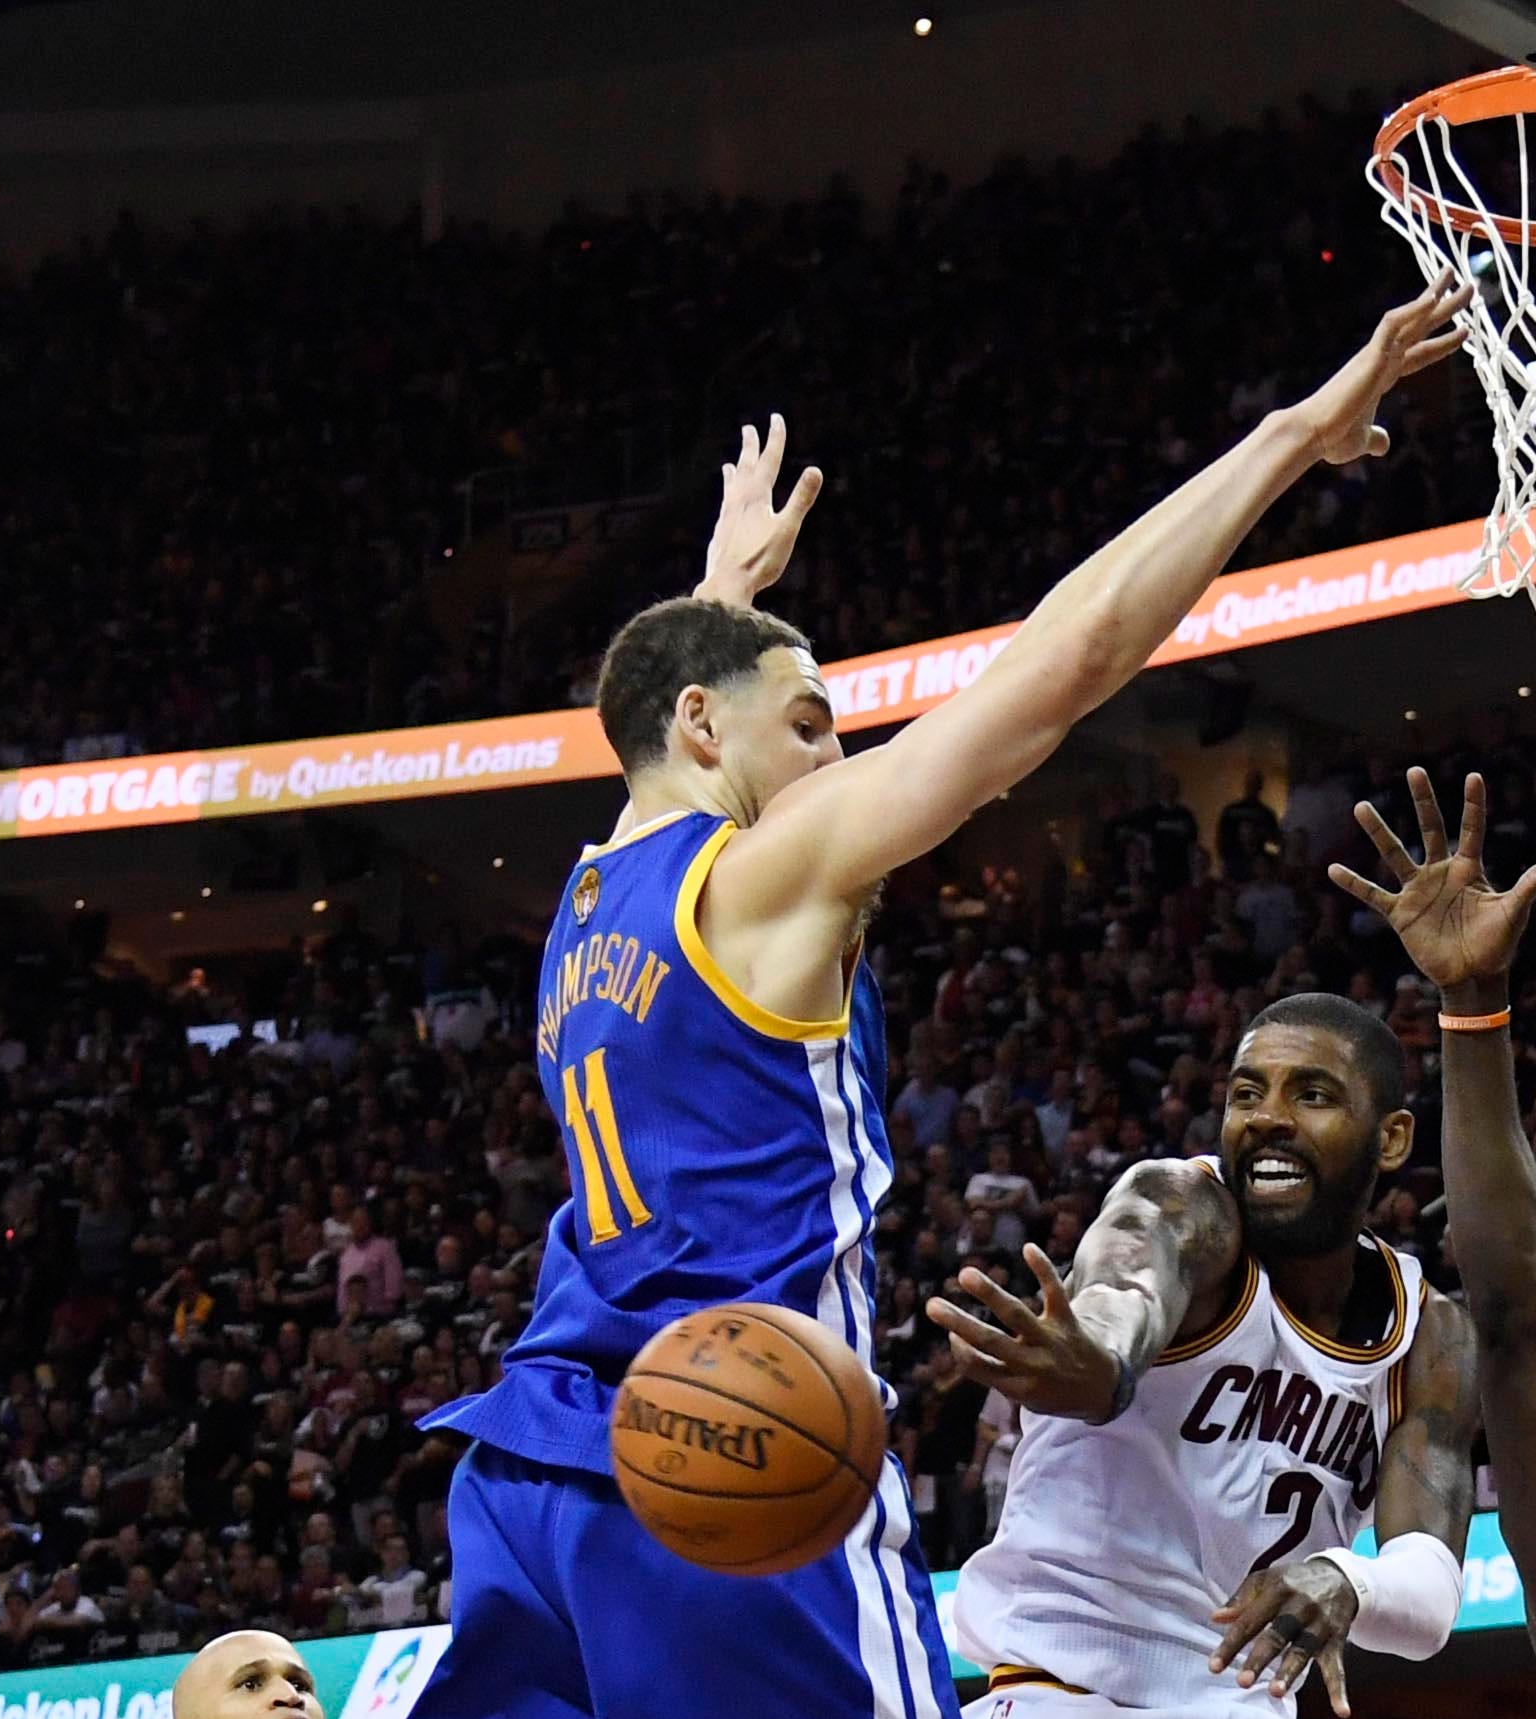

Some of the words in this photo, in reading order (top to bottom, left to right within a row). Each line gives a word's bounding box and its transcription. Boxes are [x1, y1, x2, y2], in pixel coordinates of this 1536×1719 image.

[1212, 577, 1368, 638] Quicken
[249, 770, 288, 802] by
[287, 748, 443, 799] Quicken
[443, 738, 560, 779] Loans
[563, 1047, 652, 1246] 11
[1230, 1471, 1324, 1602] 2
